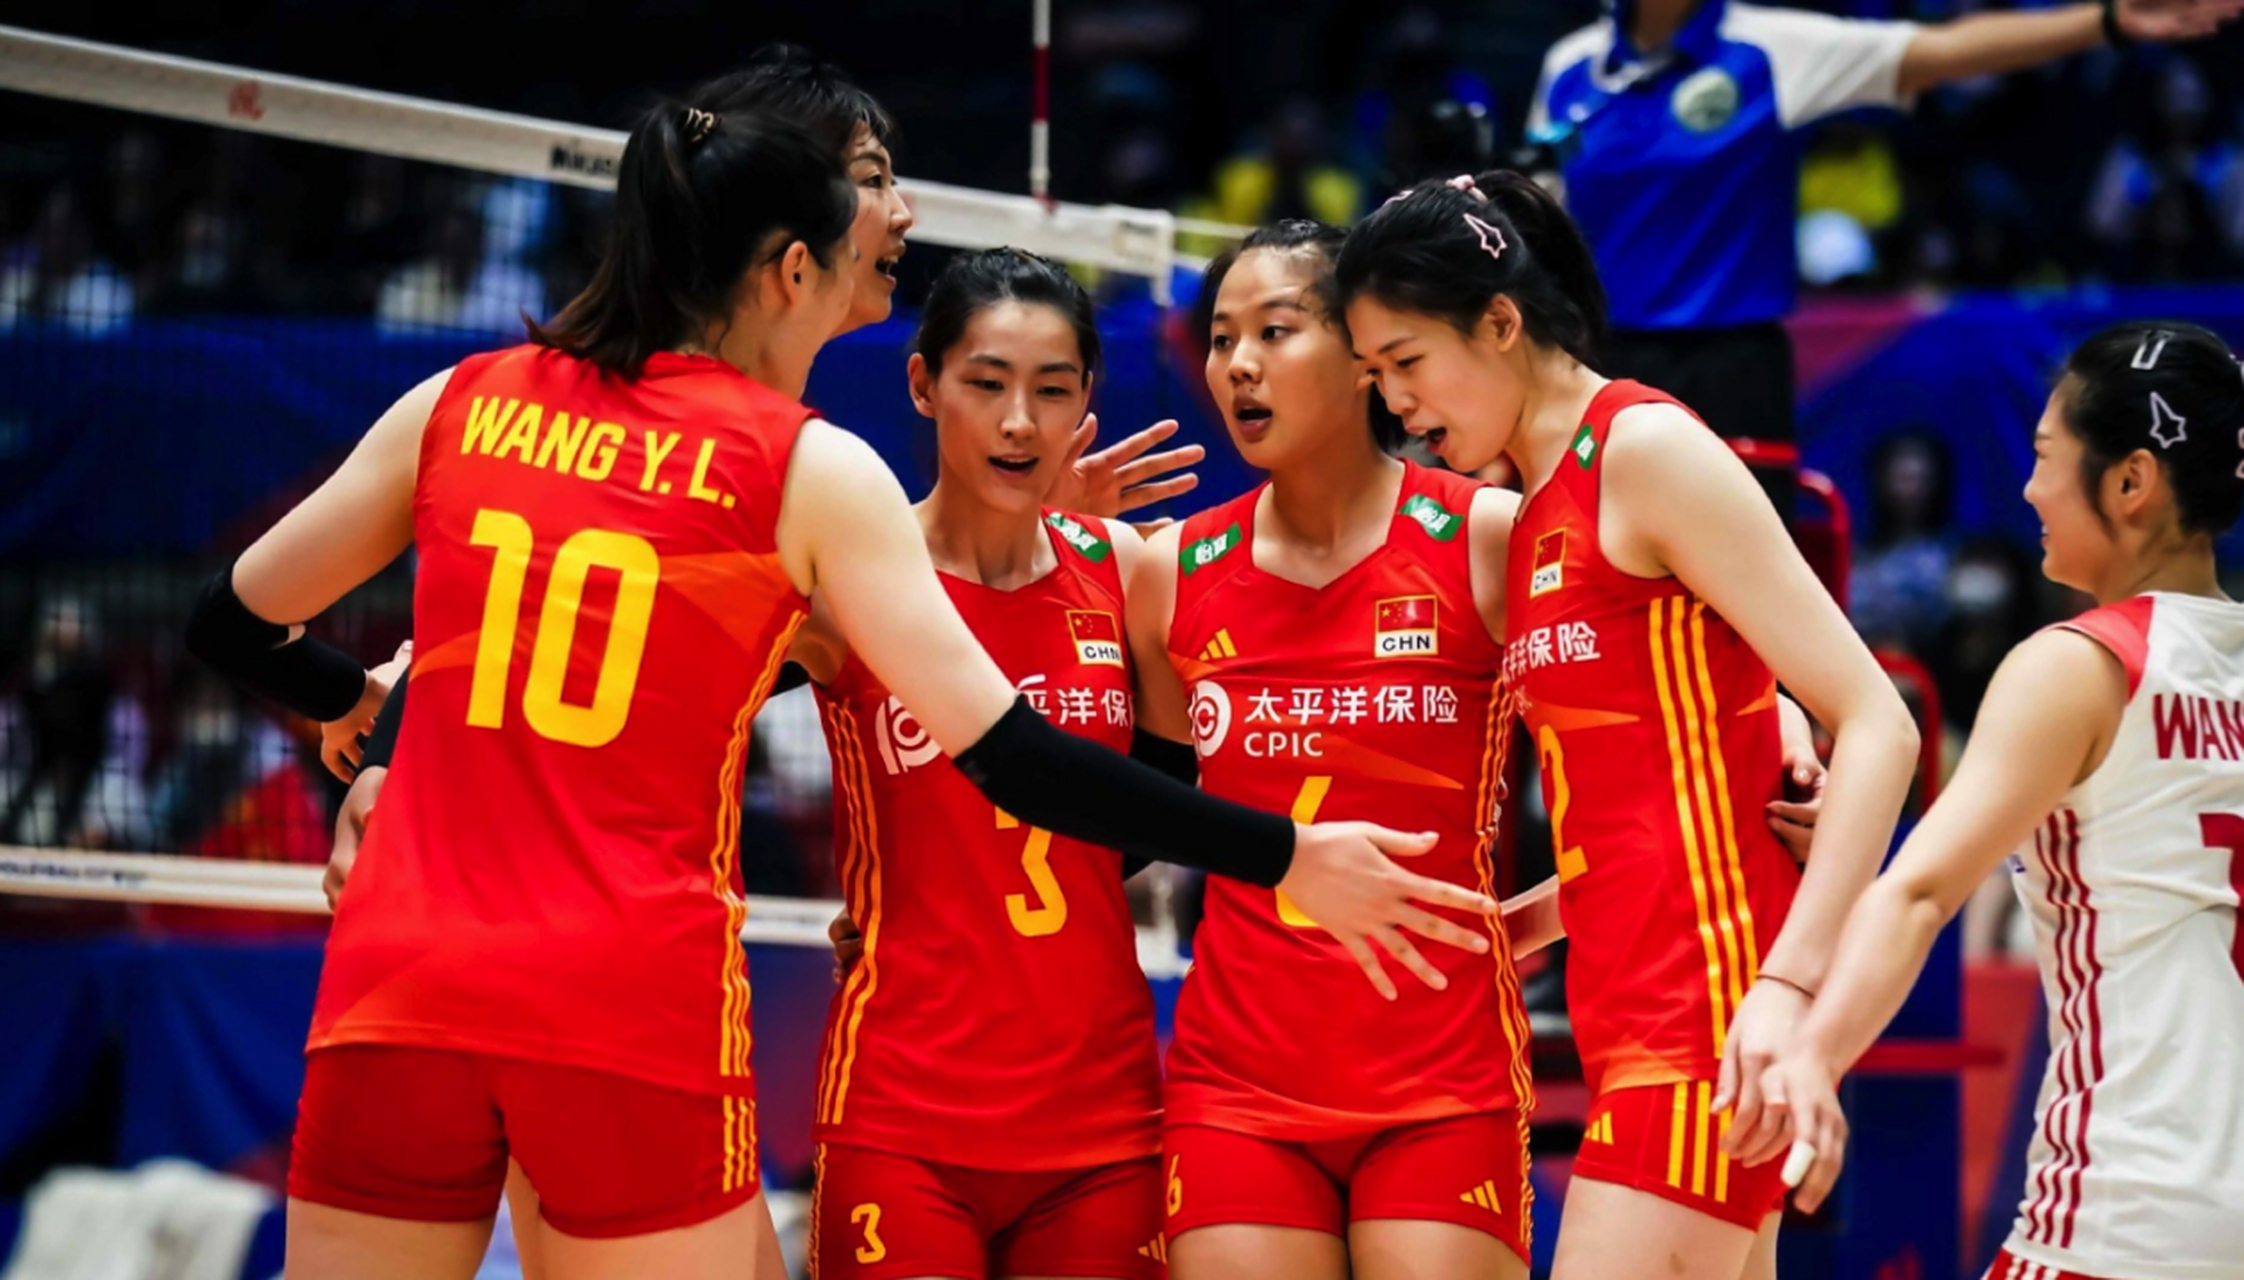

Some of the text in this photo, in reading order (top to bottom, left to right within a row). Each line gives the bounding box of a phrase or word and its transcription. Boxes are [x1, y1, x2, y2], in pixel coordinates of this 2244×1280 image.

[461, 396, 736, 510] WANG Y. L.
[466, 508, 660, 748] 10
[1382, 634, 1430, 652] CHN
[1084, 645, 1121, 661] CHN
[1244, 684, 1459, 725] 太平洋保险
[1244, 731, 1323, 758] CPIC
[850, 1202, 887, 1264] 3
